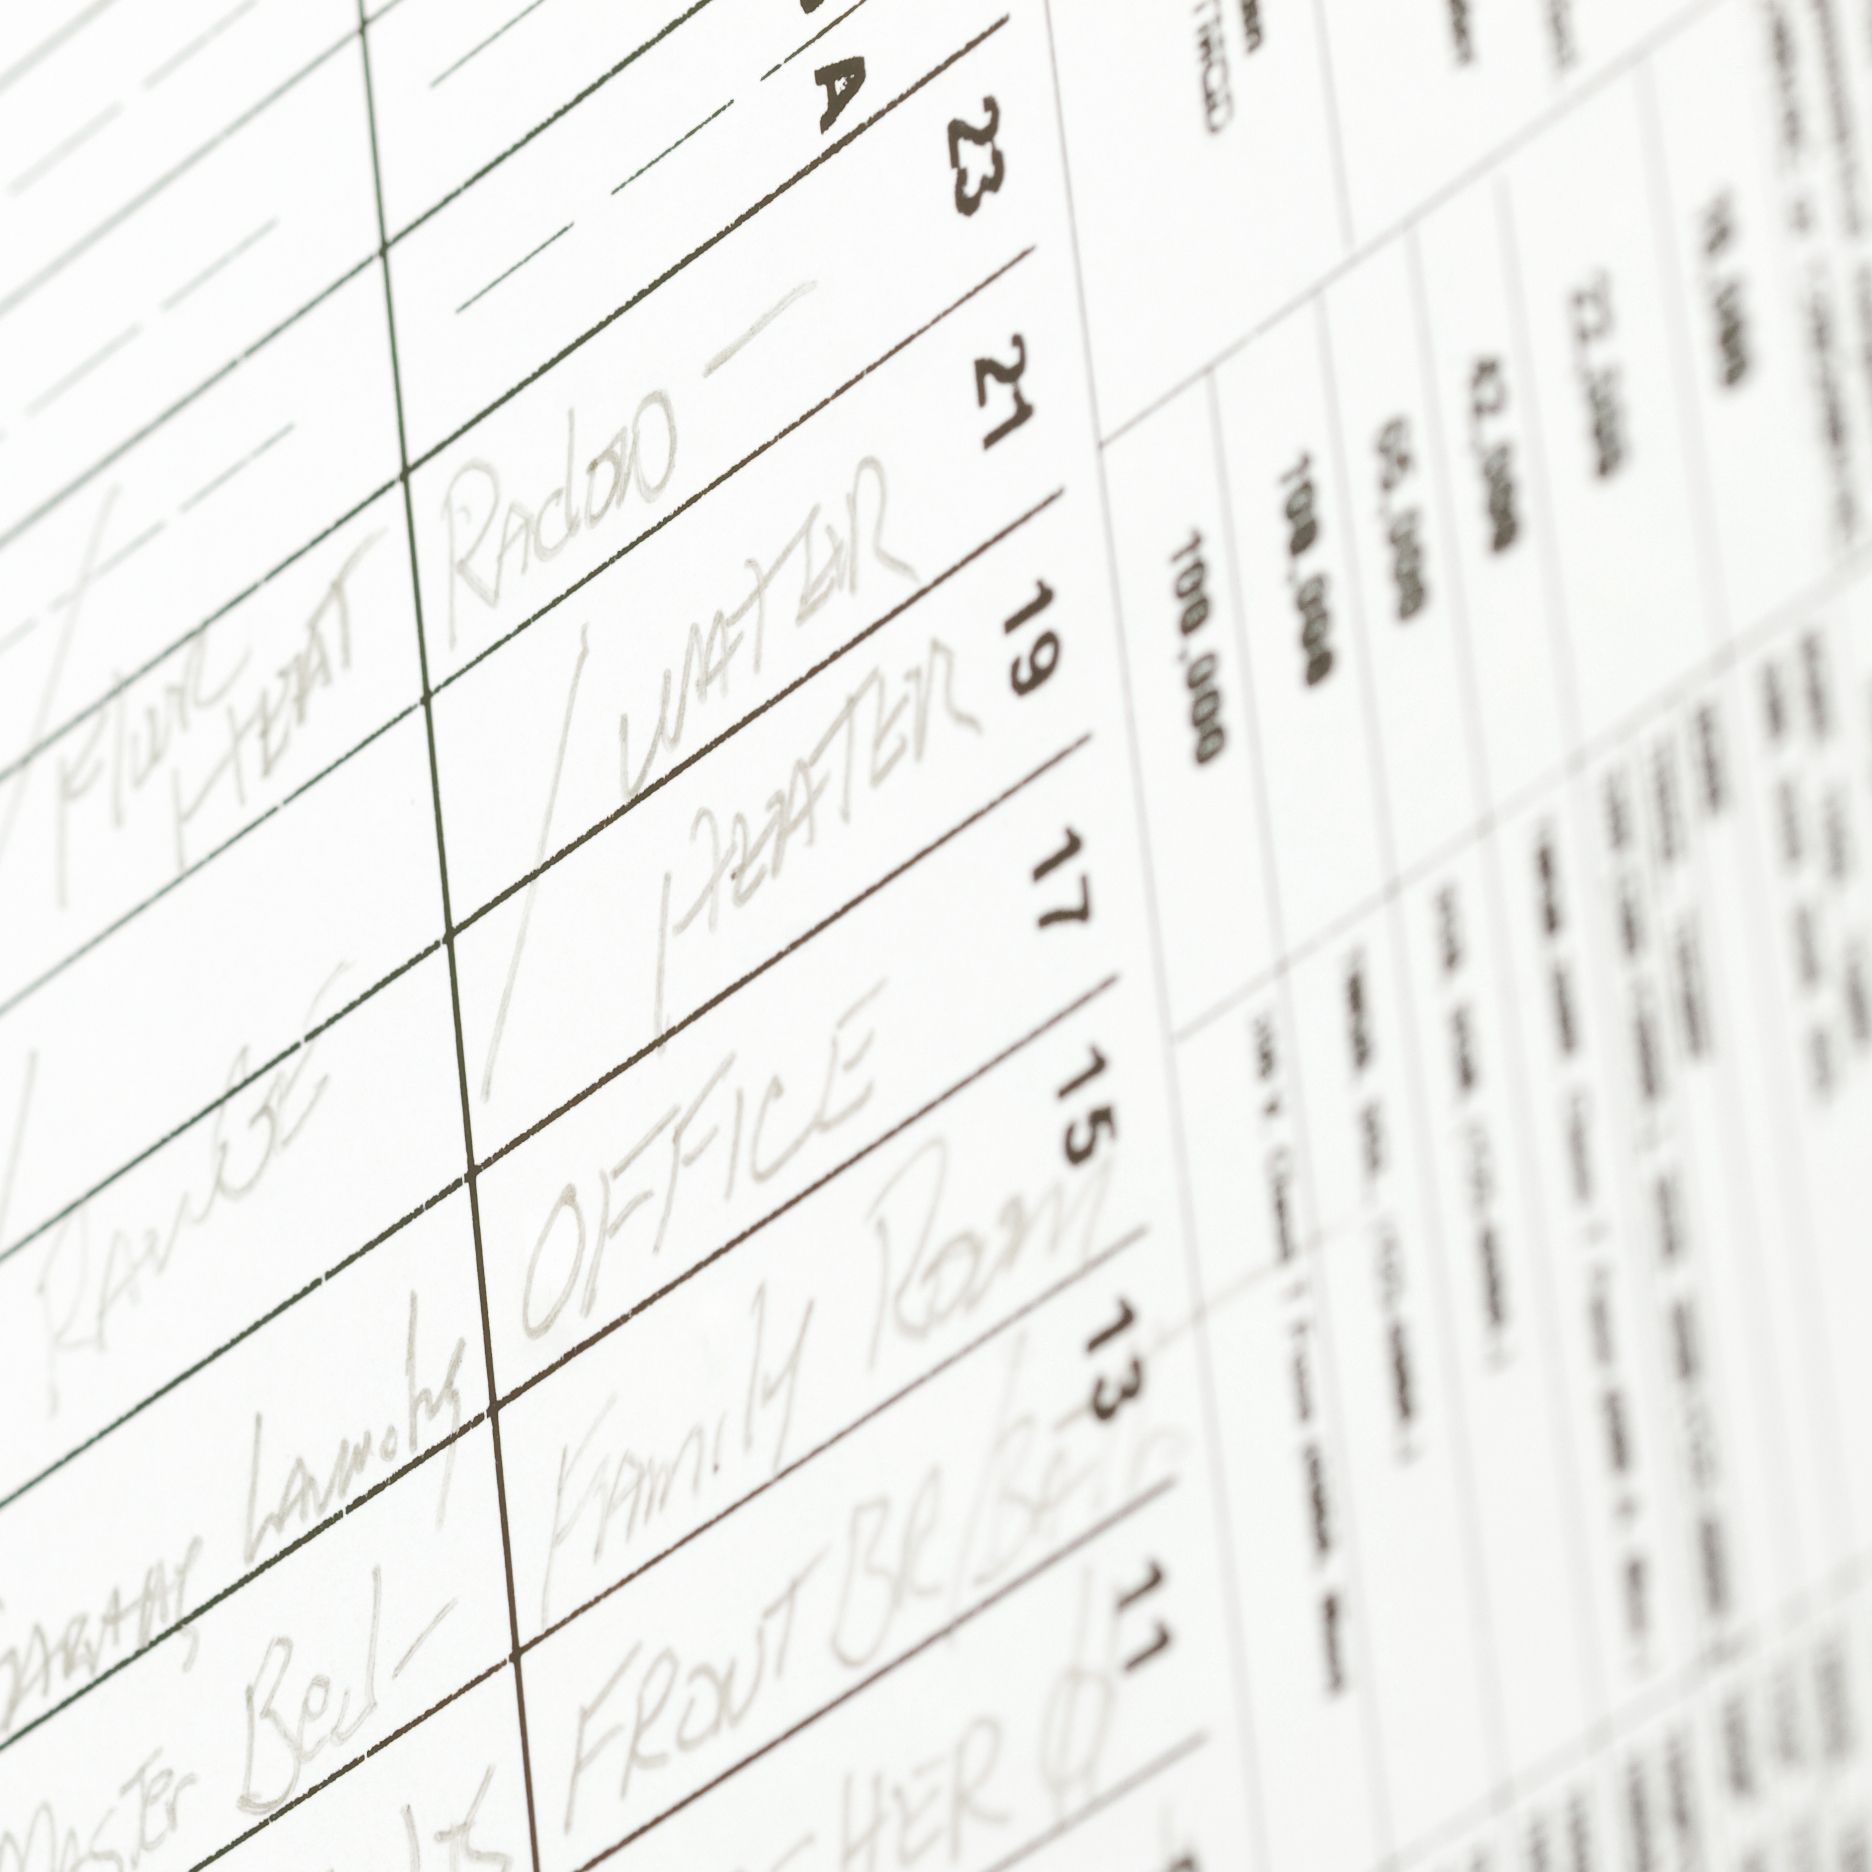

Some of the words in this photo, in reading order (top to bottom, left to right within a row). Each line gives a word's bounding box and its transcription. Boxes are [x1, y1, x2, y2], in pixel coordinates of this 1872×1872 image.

[814, 56, 866, 134] A
[947, 95, 1005, 217] 23
[974, 333, 1035, 452] 21
[1004, 580, 1061, 697] 19
[1170, 528, 1226, 766] 100,000
[1031, 826, 1091, 930] 17
[521, 976, 889, 1340] OFFICE
[1055, 1043, 1118, 1169] 15
[1087, 1297, 1145, 1424] 13
[1117, 1560, 1174, 1675] 11
